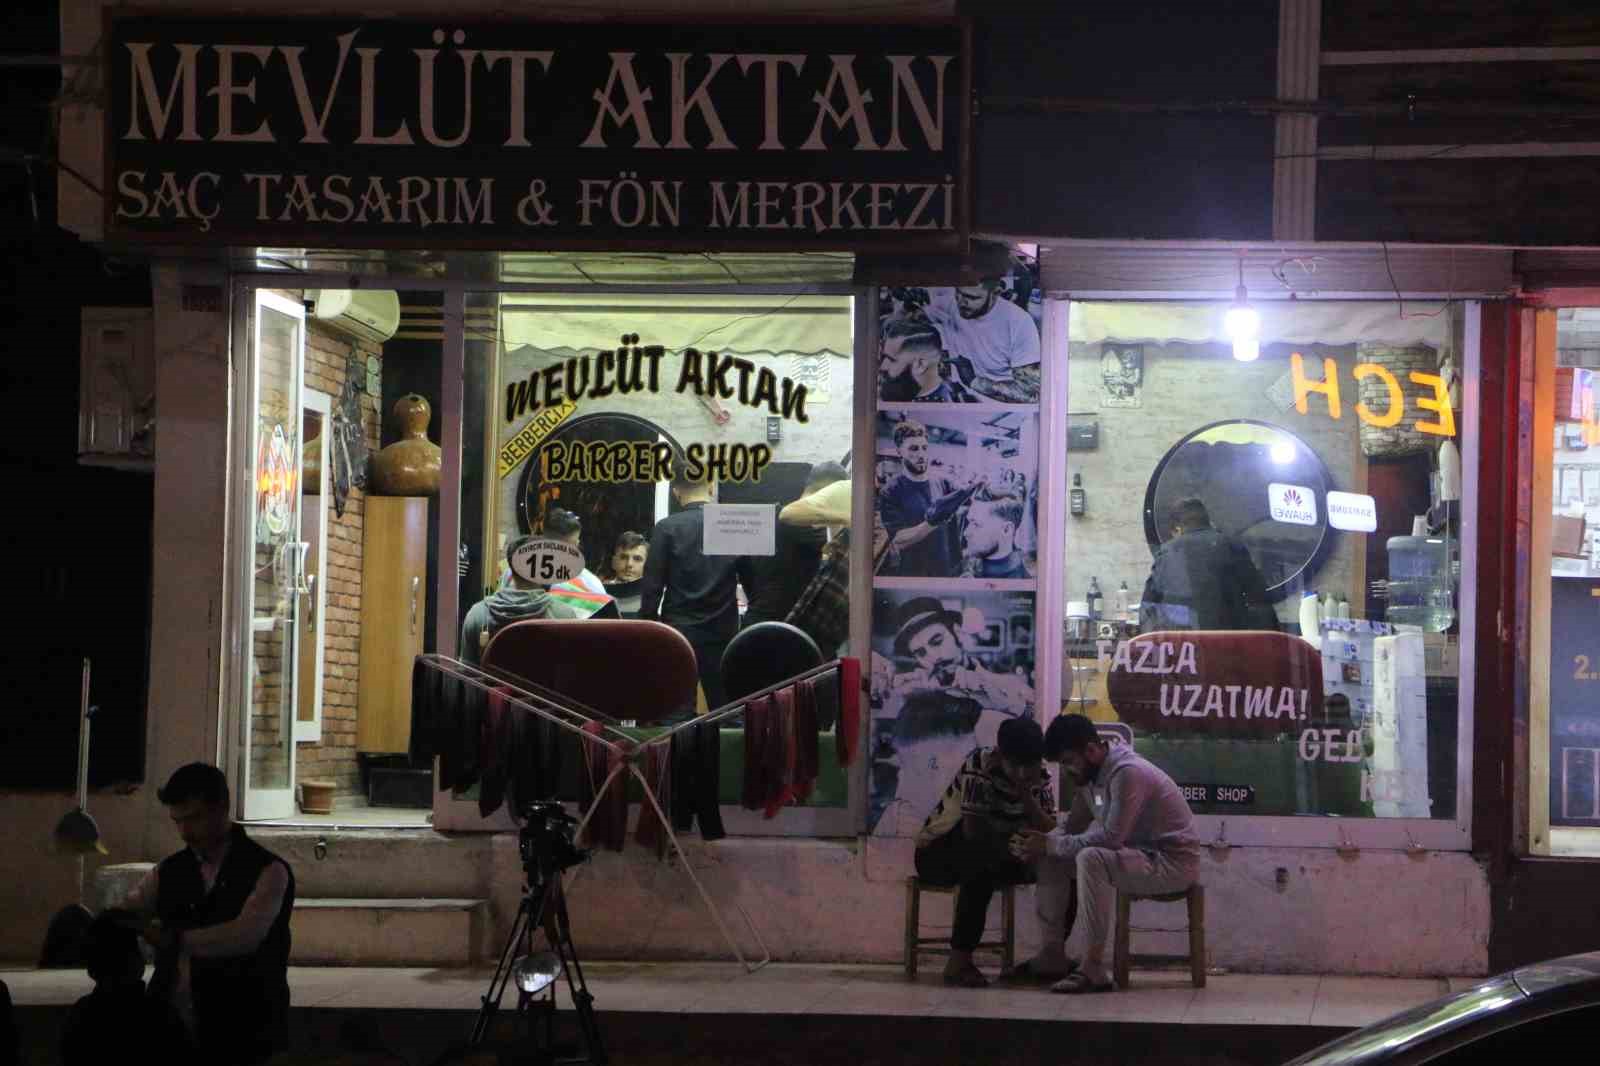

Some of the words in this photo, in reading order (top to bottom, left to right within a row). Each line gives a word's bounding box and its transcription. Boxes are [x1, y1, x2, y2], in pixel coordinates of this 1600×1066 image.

[123, 28, 555, 149] MEVLÜT
[579, 51, 955, 153] AKTAN
[114, 170, 222, 232] SAÇ
[243, 172, 495, 228] TASARIM
[515, 178, 558, 226] &
[578, 172, 682, 229] FÖN
[708, 174, 956, 234] MERKEZİ
[676, 347, 809, 423] AKTAN
[546, 440, 673, 483] BARBER
[685, 442, 771, 483] SHOP
[525, 554, 554, 578] 15
[556, 565, 570, 580] dk
[1159, 685, 1307, 722] UZATMA!
[1216, 786, 1248, 802] SHOP
